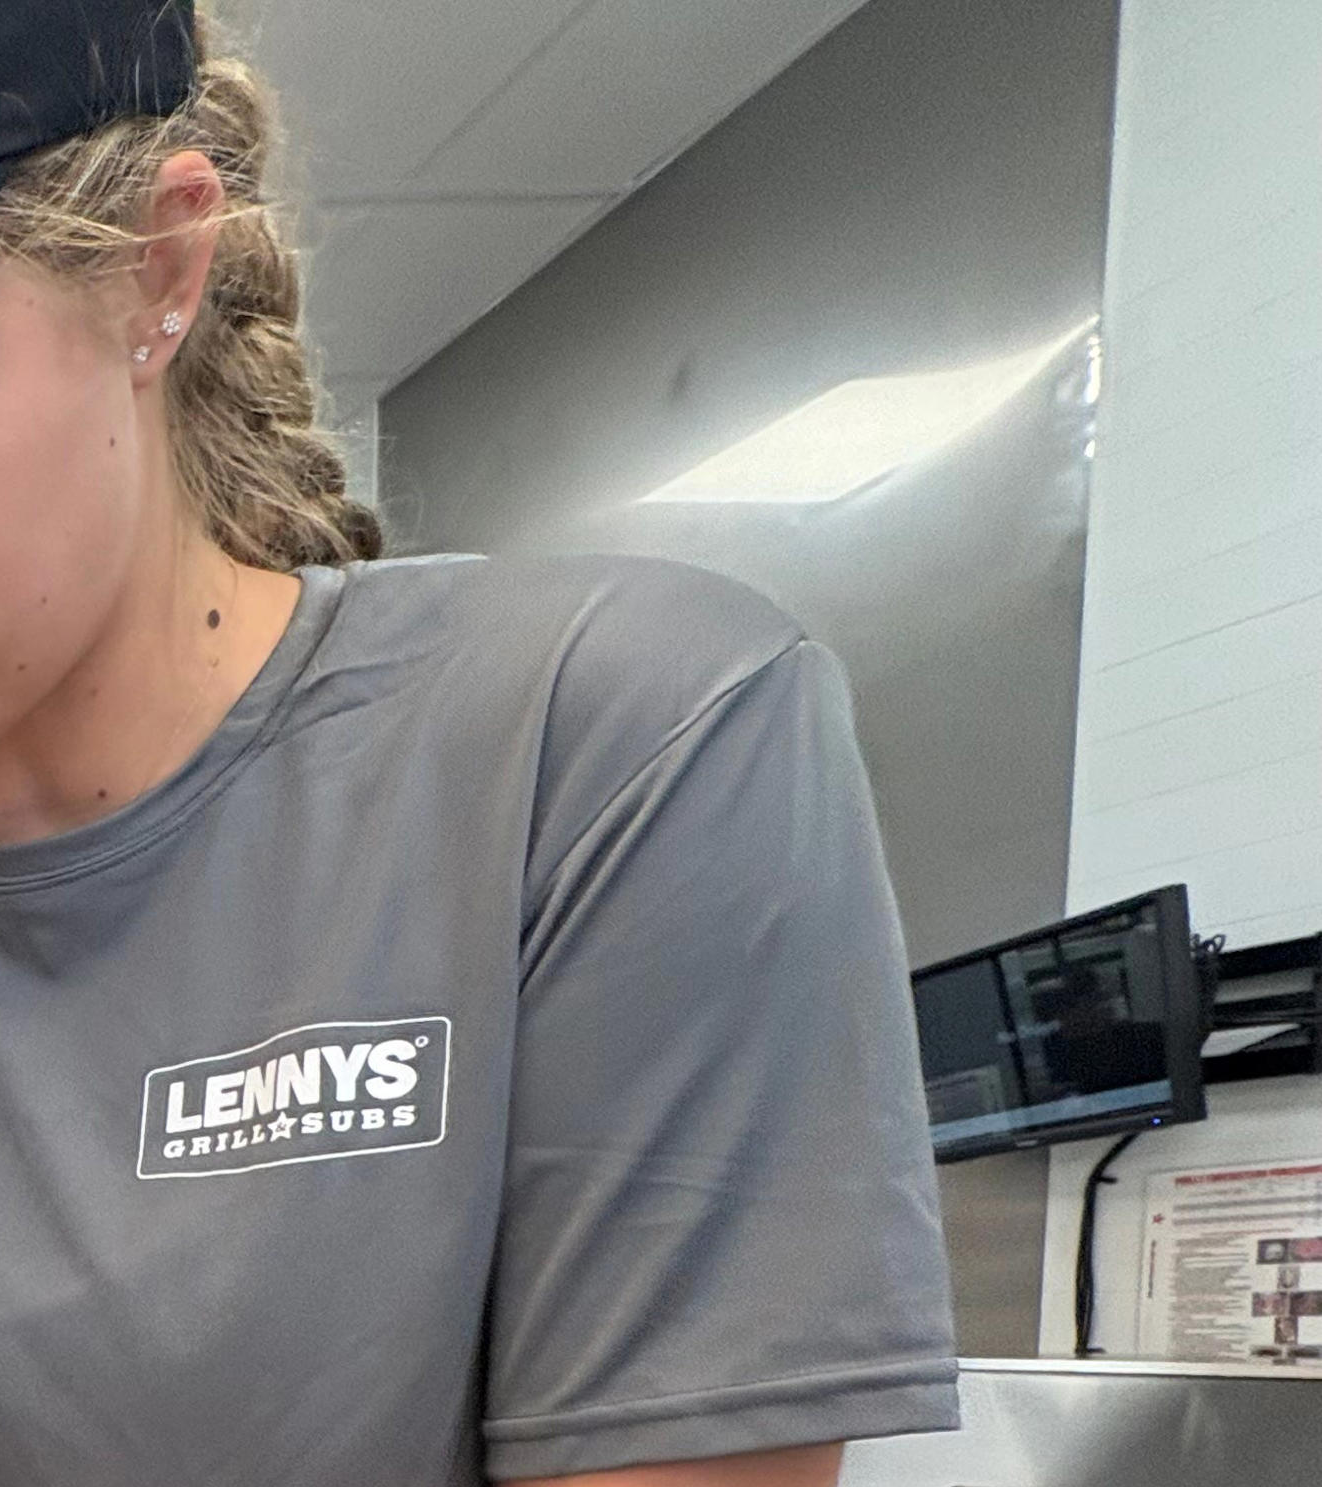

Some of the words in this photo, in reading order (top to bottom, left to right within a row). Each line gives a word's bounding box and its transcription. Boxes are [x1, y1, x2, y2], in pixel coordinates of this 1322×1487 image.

[165, 1038, 418, 1134] LENNYS
[162, 1124, 266, 1159] GRILL
[300, 1105, 417, 1135] SUBS
